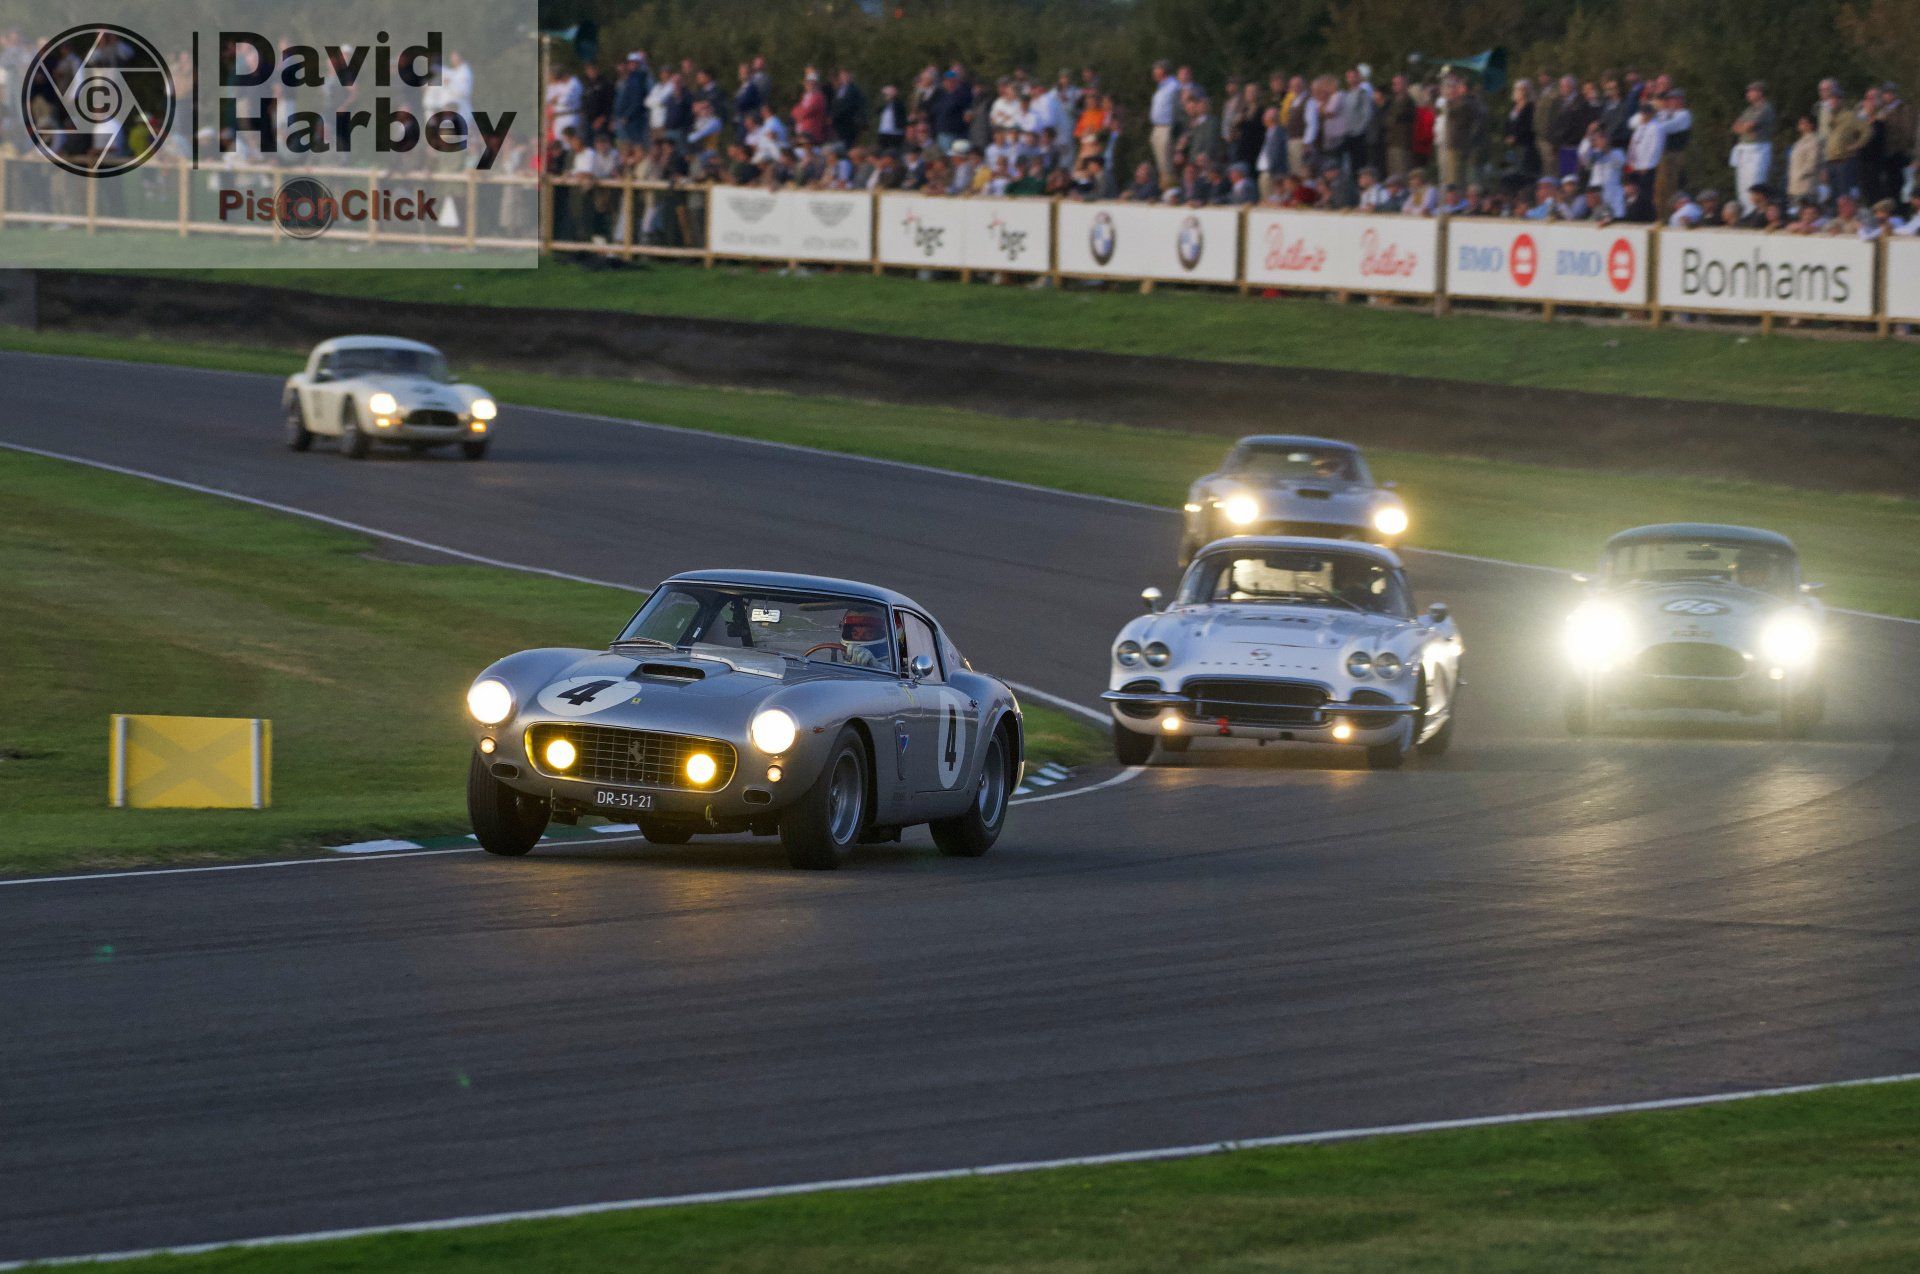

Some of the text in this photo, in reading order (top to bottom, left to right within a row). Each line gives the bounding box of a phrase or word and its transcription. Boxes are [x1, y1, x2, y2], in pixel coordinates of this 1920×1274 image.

[1682, 247, 1849, 303] Bonhams
[556, 679, 618, 706] 4
[944, 703, 957, 772] 4
[597, 791, 651, 808] DR-51-21
